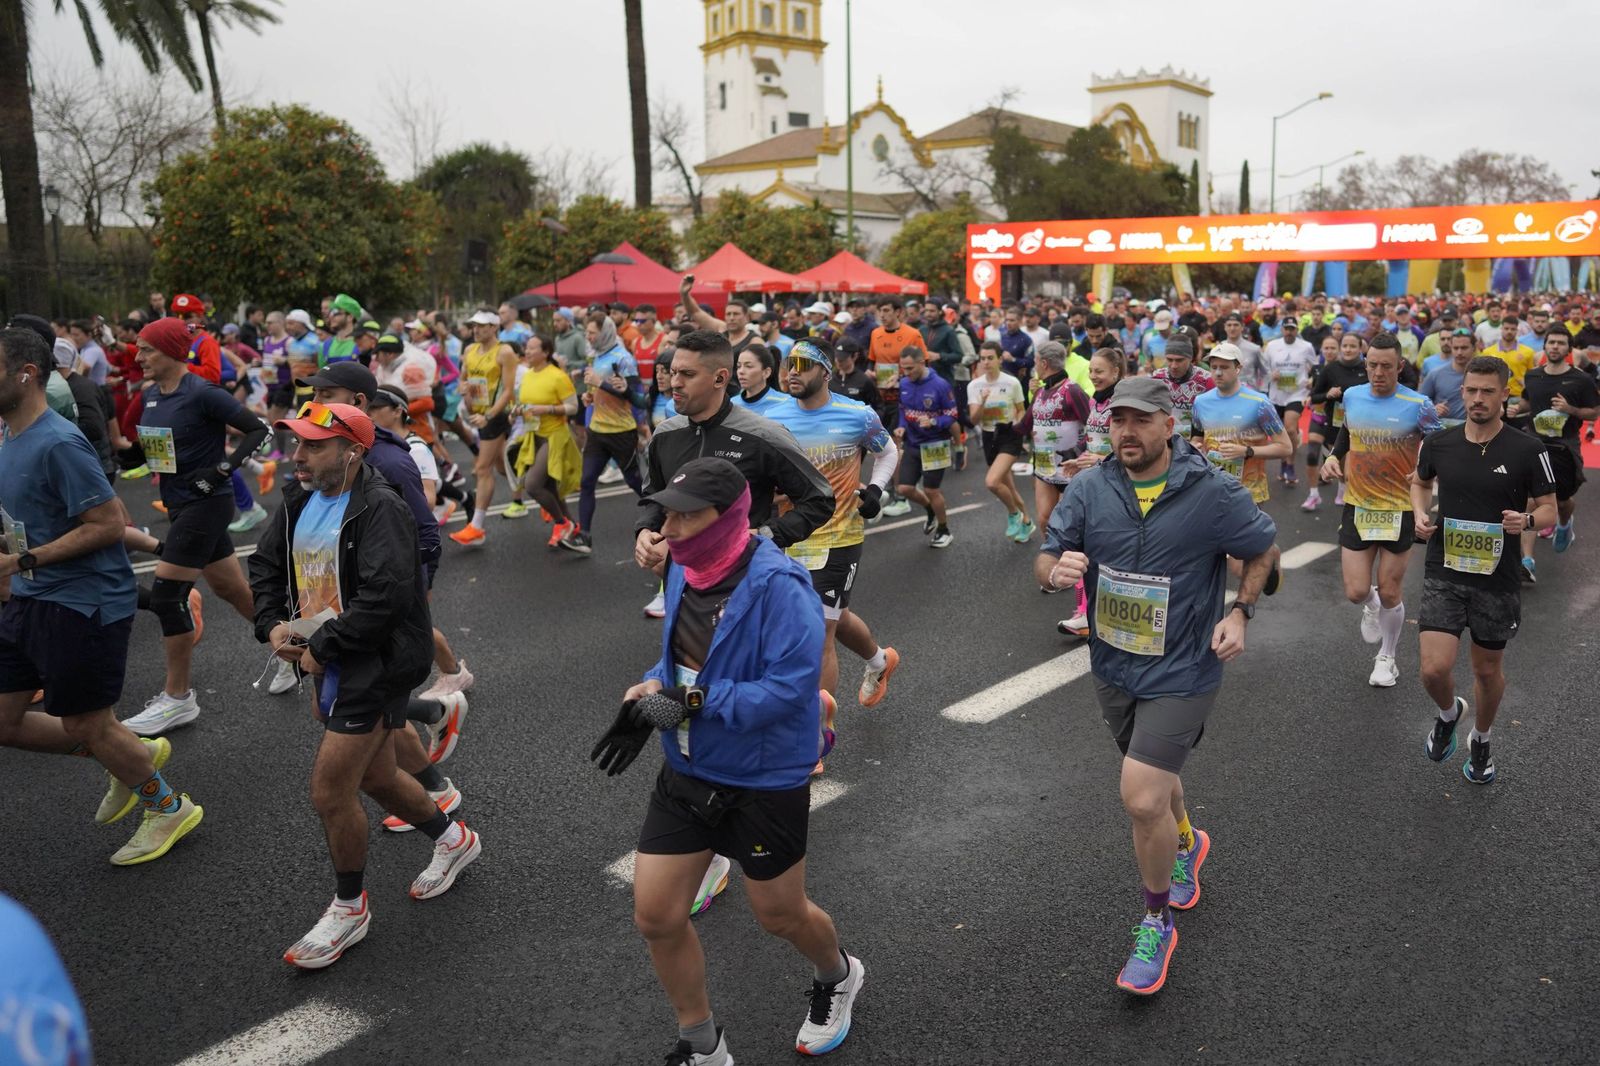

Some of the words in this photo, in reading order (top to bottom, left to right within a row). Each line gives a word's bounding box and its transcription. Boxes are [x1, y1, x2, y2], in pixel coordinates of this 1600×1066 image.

[1359, 512, 1394, 524] 10358
[1448, 531, 1493, 552] 12988
[1102, 594, 1154, 625] 10804
